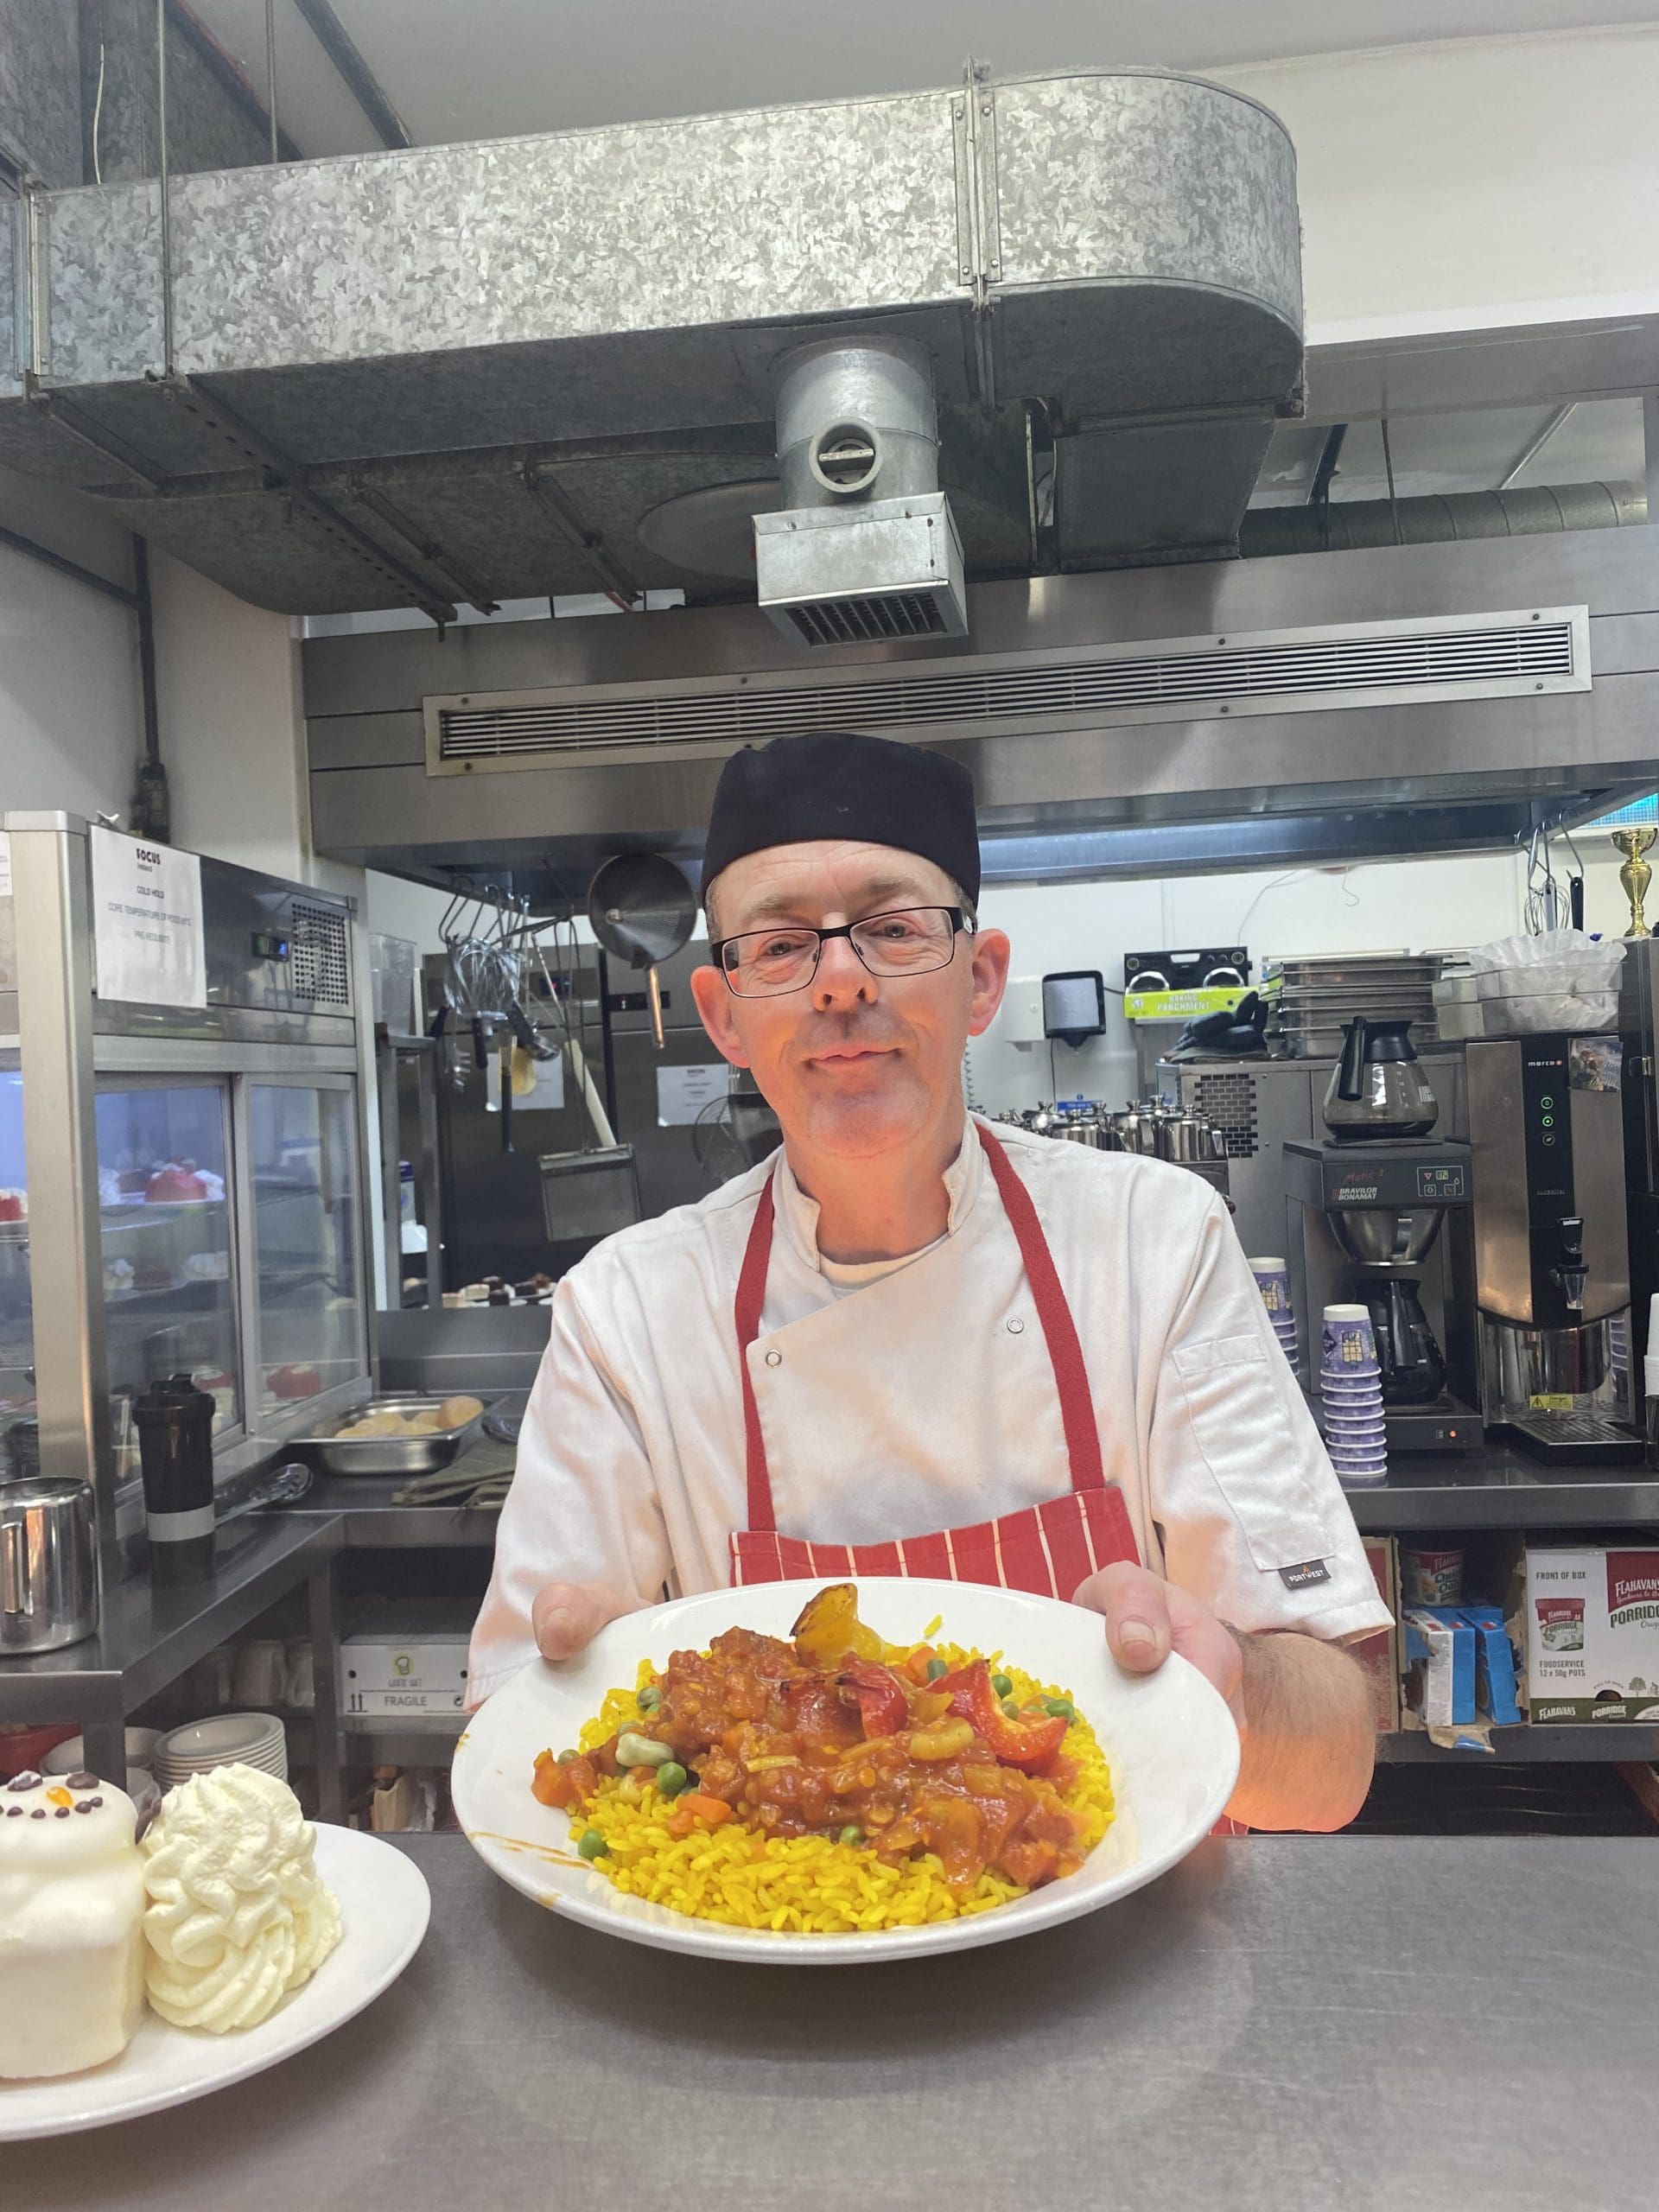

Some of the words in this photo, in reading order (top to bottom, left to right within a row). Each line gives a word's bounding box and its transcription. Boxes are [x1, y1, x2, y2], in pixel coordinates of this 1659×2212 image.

[136, 848, 162, 866] FOCUS
[1157, 1001, 1210, 1011] PARCHMENT
[1339, 1186, 1378, 1196] BRAVILOR
[1288, 1569, 1325, 1582] PORTWEST
[1535, 1571, 1559, 1580] FRONT
[1560, 1571, 1570, 1580] OF
[1572, 1571, 1587, 1580] BOX
[1539, 1659, 1586, 1669] FOODSERVICE
[1540, 1669, 1548, 1677] 12
[1568, 1669, 1586, 1677] POTS
[384, 1696, 428, 1707] FRAGILE
[1592, 1705, 1627, 1719] PORRIDGE
